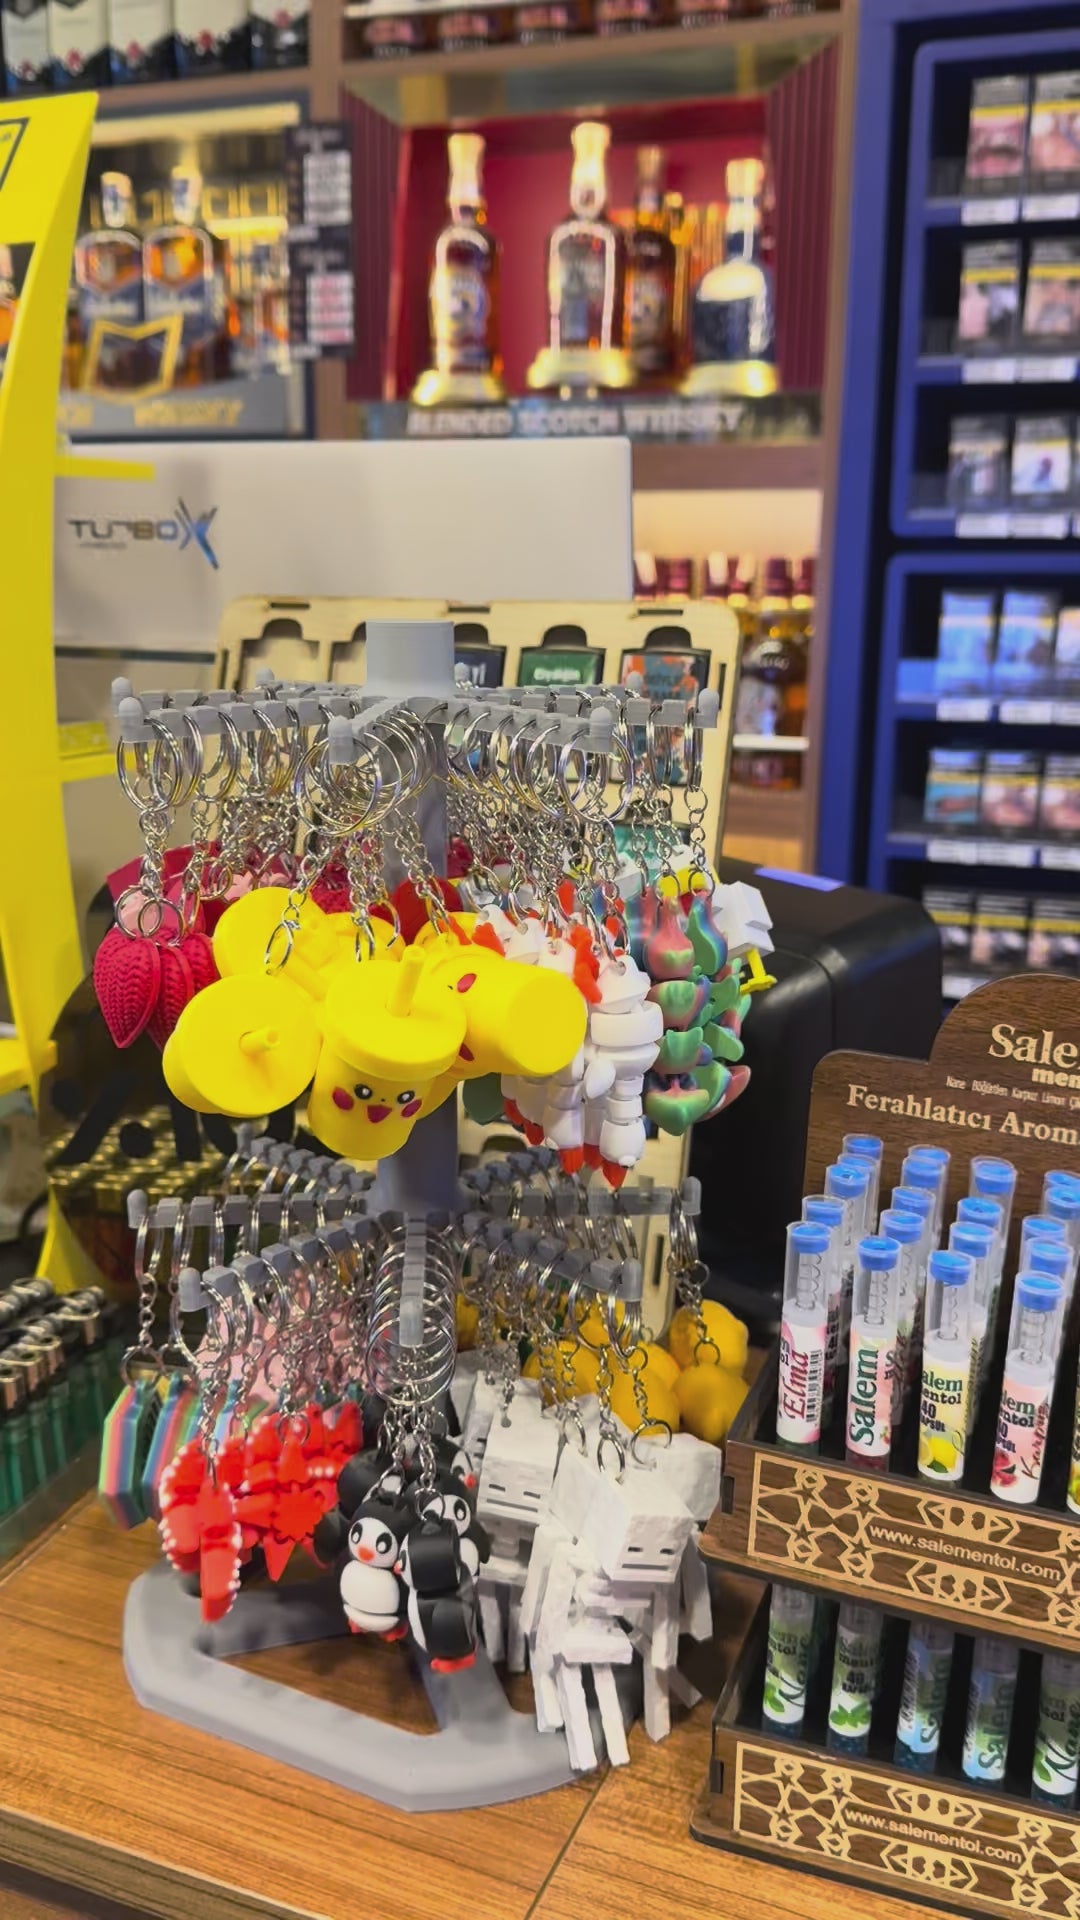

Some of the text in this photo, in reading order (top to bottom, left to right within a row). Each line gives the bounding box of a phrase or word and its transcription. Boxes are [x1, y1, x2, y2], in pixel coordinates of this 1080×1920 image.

[988, 1023, 1080, 1070] Sale
[846, 1084, 1080, 1146] Ferahlatıcı Arom
[783, 1348, 809, 1419] Elma
[850, 1348, 879, 1446] Salem
[922, 1370, 963, 1392] alem
[922, 1388, 962, 1405] entol
[1000, 1389, 1036, 1417] lem
[1000, 1407, 1035, 1428] ntol
[868, 1524, 1062, 1582] www.salementol.com
[845, 1808, 1023, 1865] www.salementol.com
